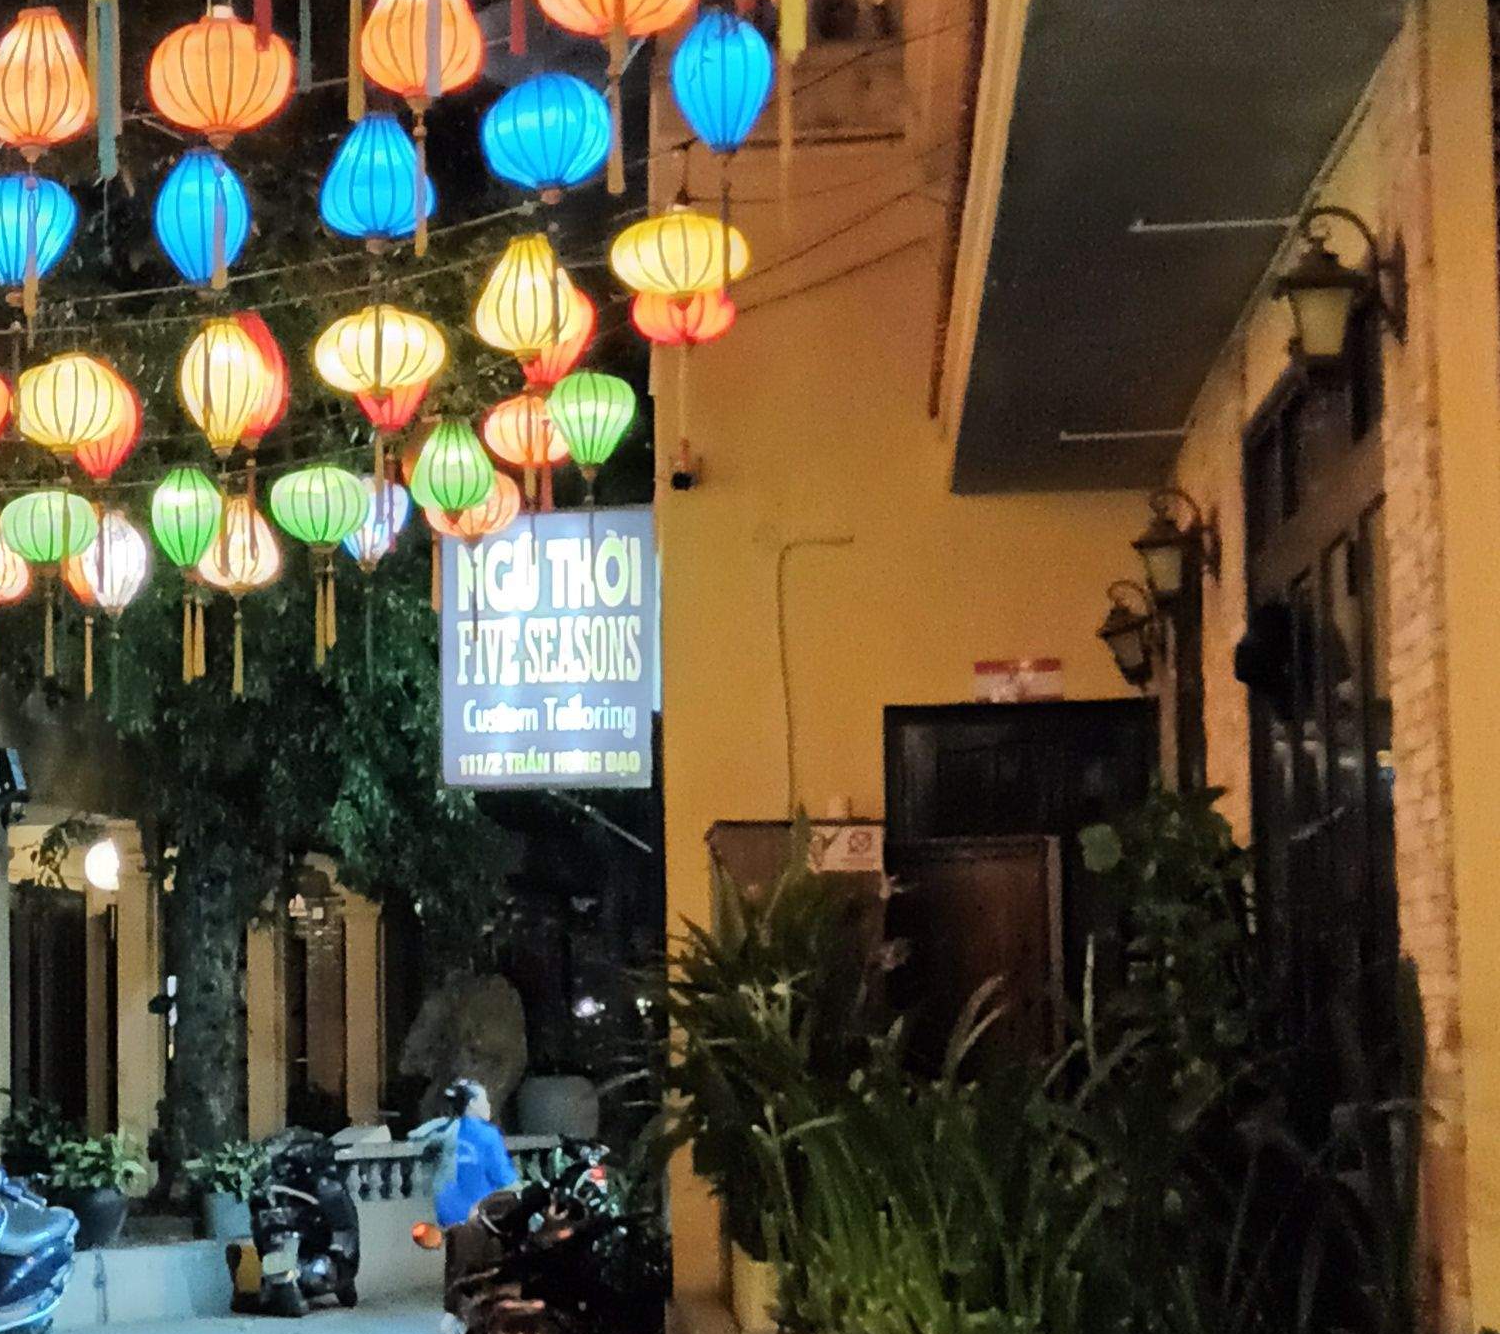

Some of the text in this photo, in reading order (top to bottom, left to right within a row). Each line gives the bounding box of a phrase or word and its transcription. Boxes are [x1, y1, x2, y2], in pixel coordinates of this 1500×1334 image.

[457, 615, 641, 686] FIVE SEASONS
[463, 693, 636, 739] Custom Tailoring
